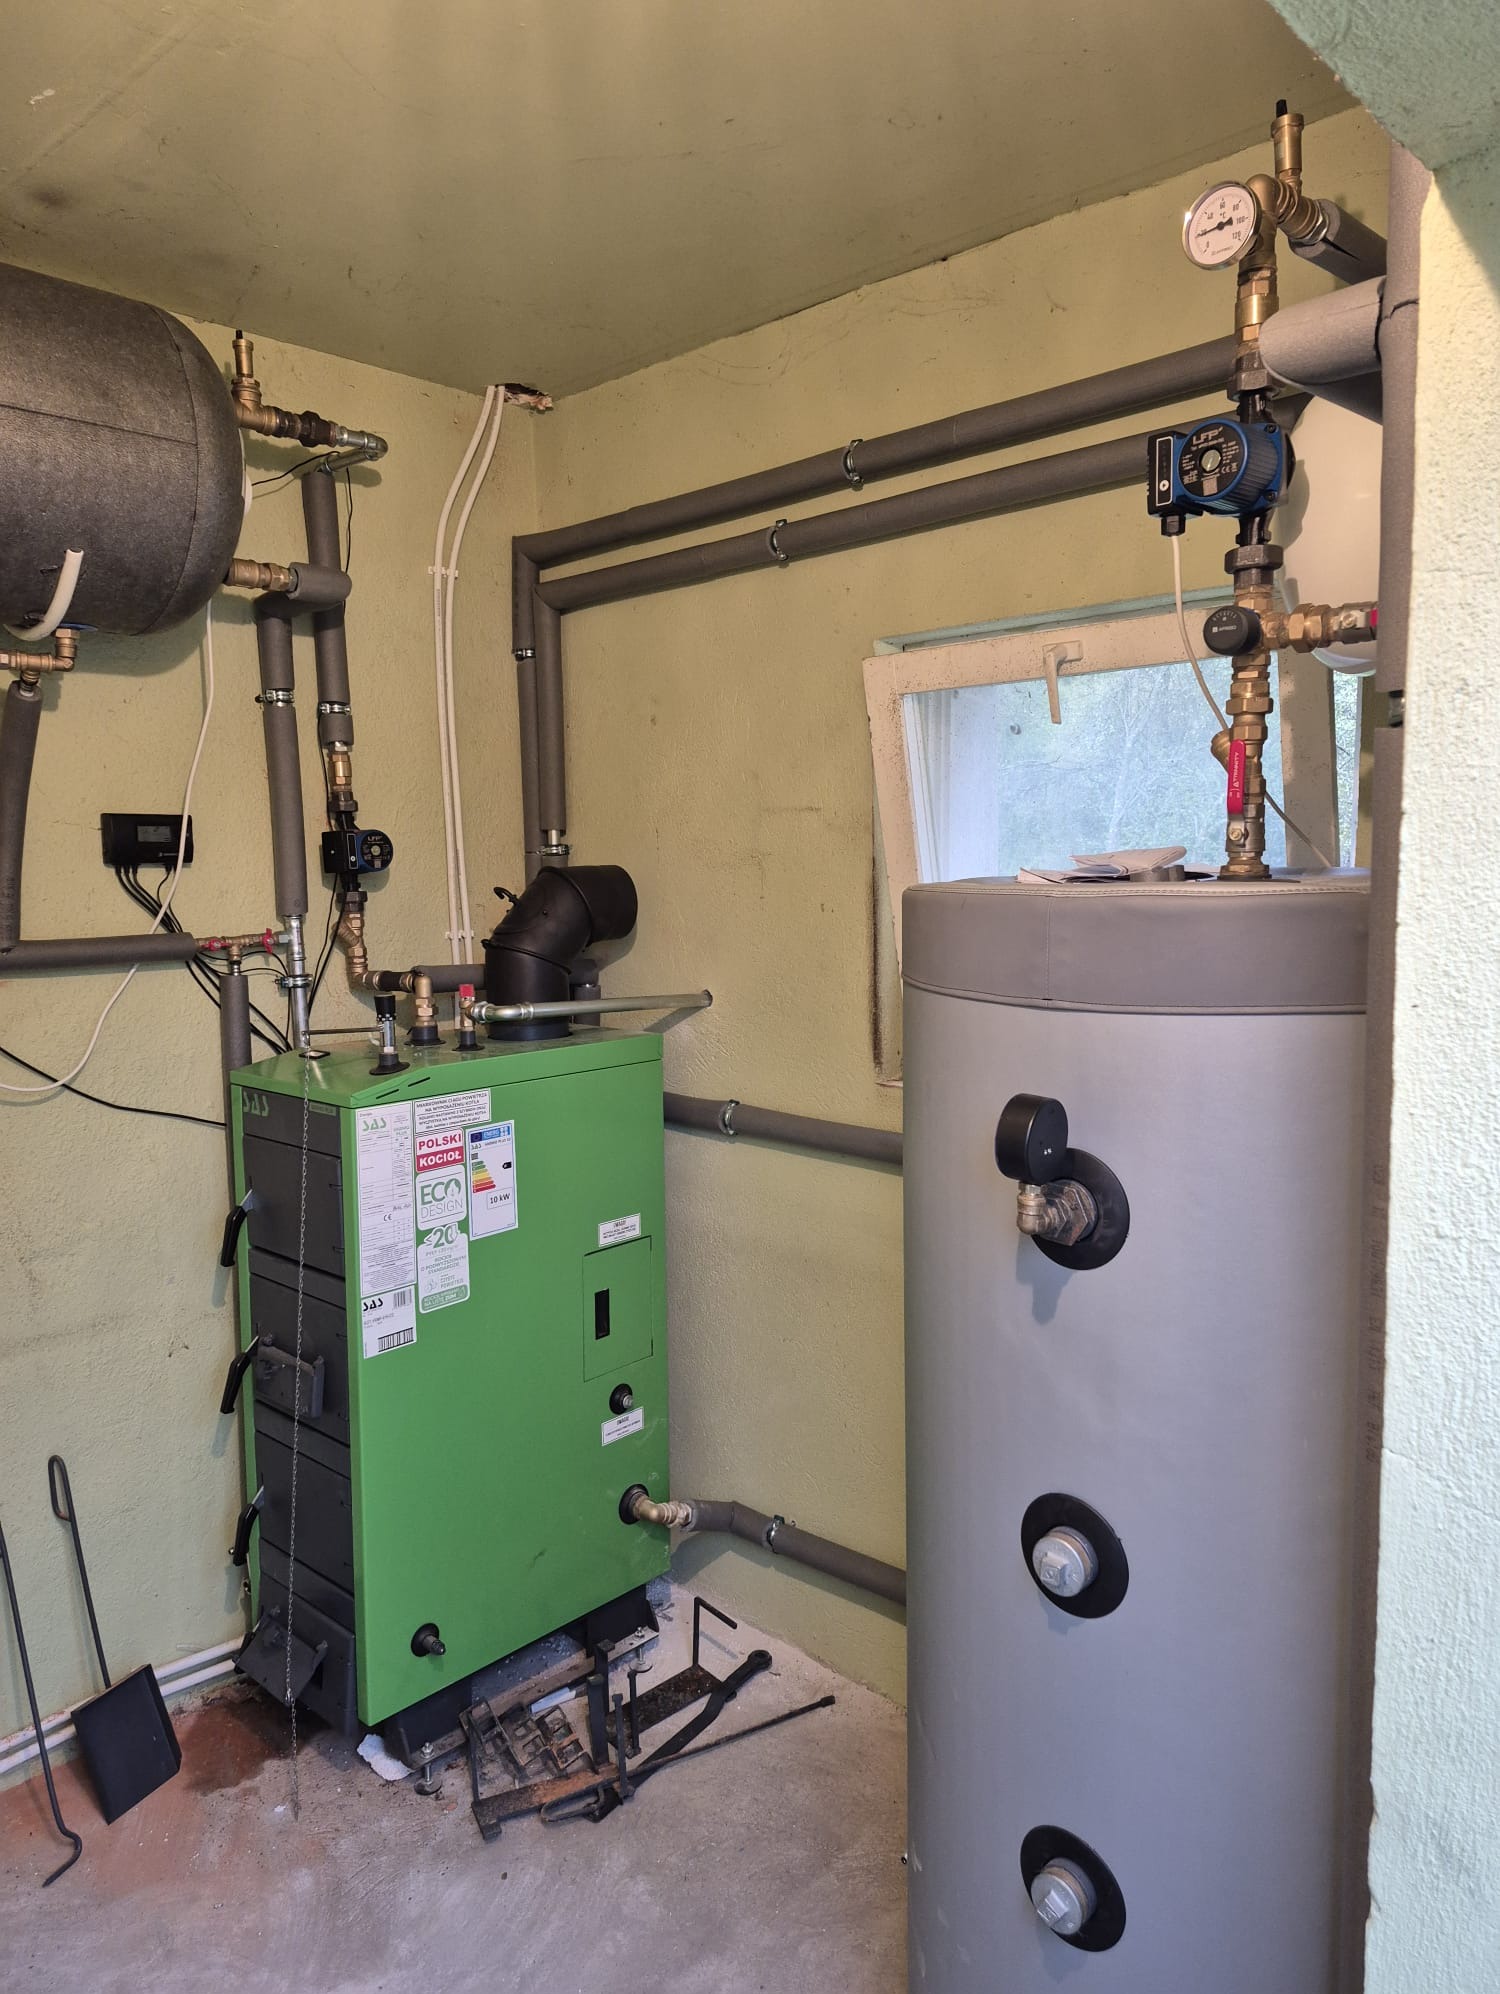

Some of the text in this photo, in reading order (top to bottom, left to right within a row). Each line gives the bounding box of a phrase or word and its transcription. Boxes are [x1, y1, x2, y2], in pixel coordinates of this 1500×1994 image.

[1193, 427, 1221, 446] LFP
[418, 1133, 461, 1151] POLSKI
[419, 1150, 462, 1168] KOCIOŁ
[420, 1178, 462, 1206] ECO
[490, 1193, 510, 1204] 10 kW
[421, 1200, 463, 1219] DESIGN
[362, 1297, 384, 1312] SAS
